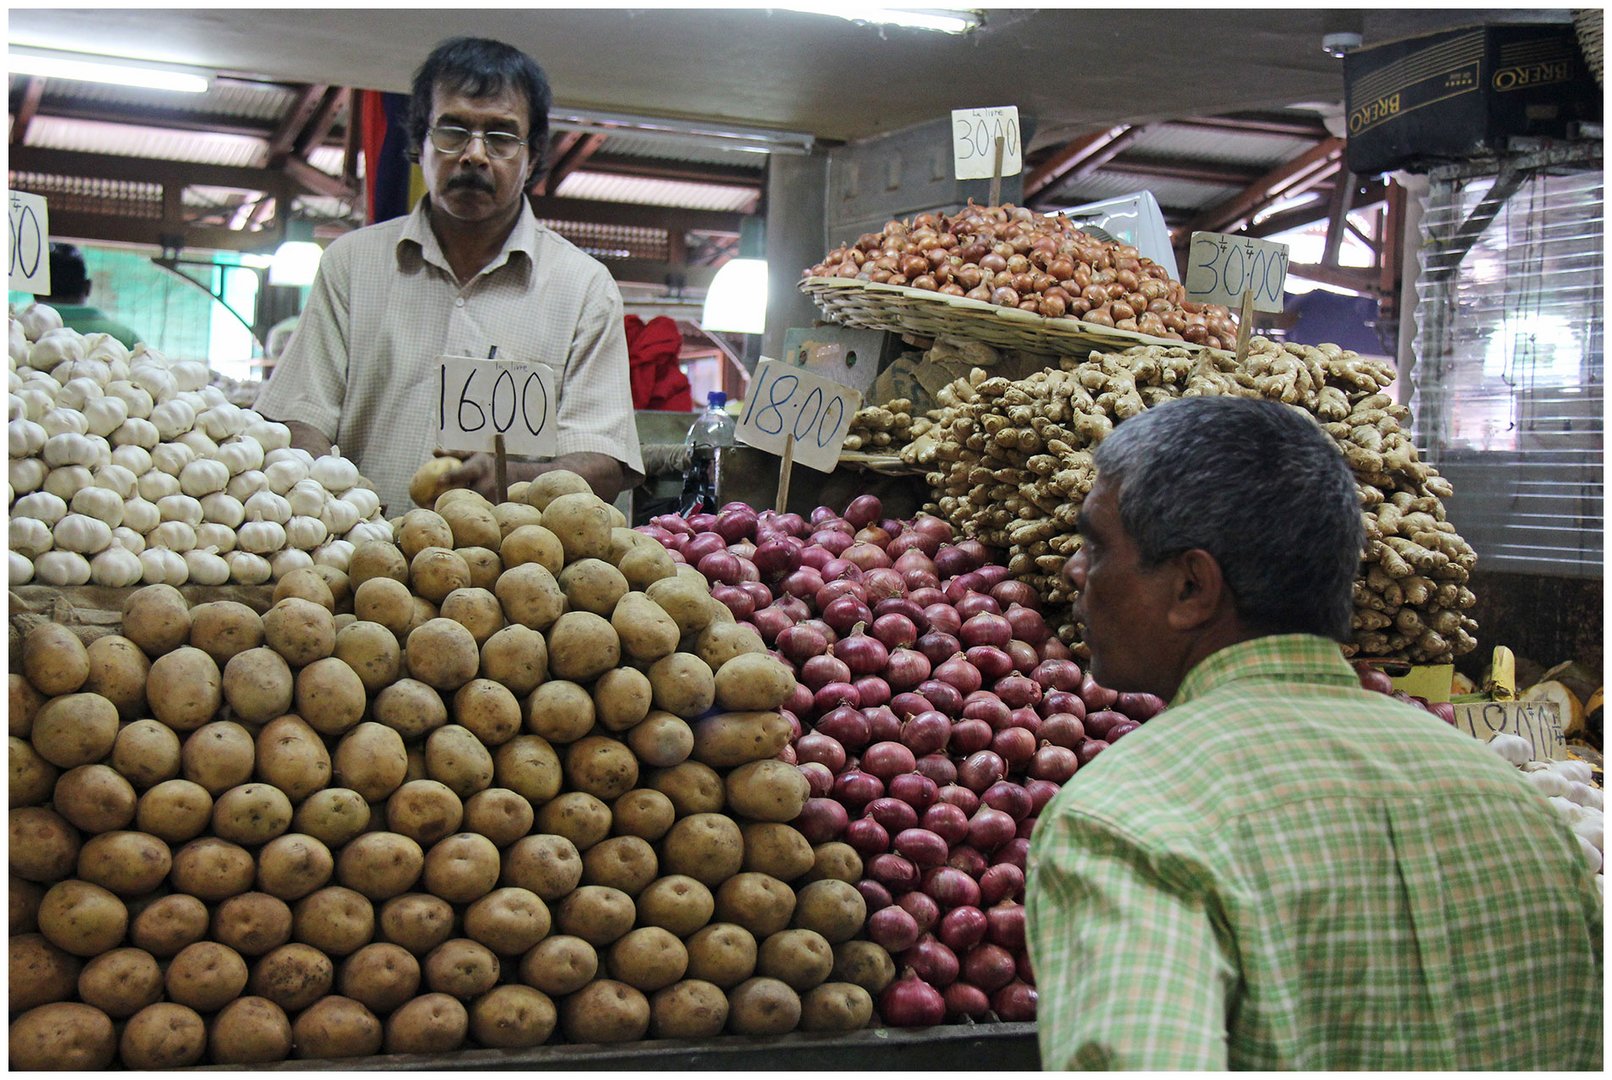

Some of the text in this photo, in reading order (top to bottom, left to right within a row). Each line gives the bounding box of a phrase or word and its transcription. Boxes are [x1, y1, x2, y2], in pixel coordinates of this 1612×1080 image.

[1495, 62, 1568, 89] BRERO
[1349, 92, 1401, 133] BRERO
[743, 365, 844, 449] 18.00
